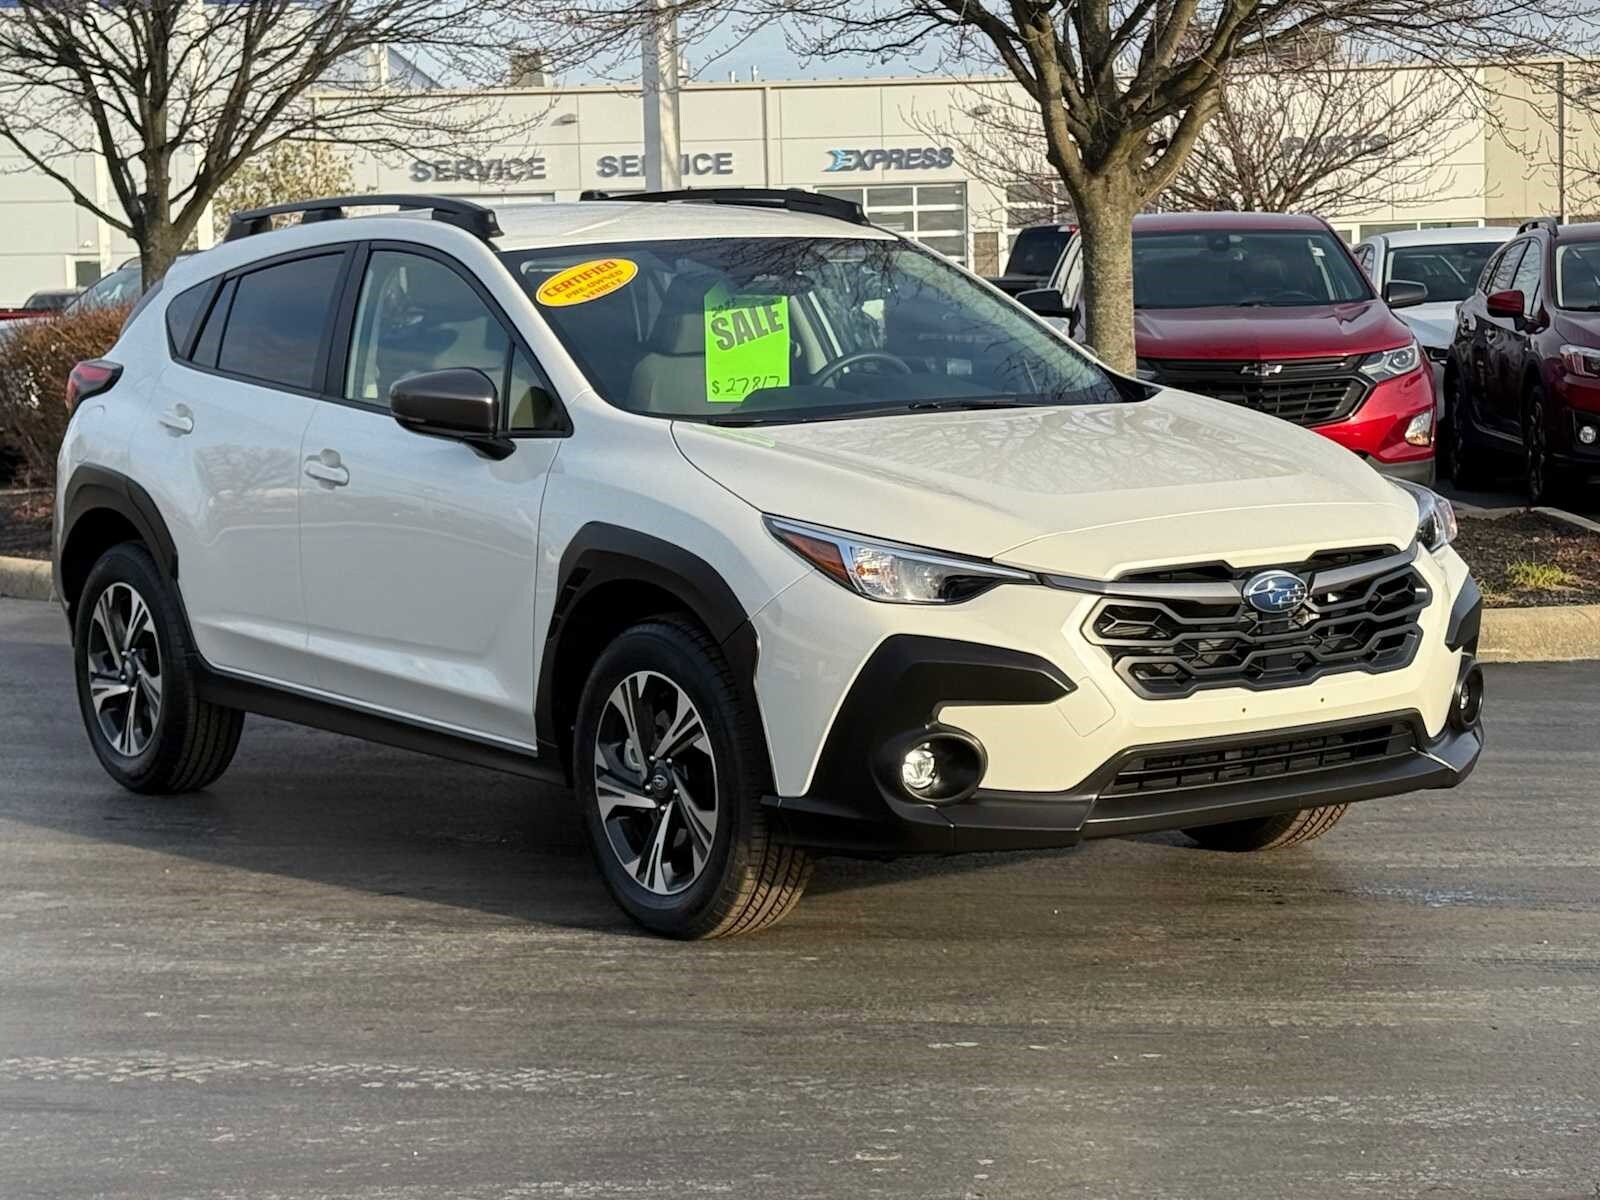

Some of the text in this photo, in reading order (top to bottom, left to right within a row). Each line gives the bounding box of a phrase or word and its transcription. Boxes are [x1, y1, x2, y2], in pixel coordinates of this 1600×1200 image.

[409, 157, 546, 182] SERVICE
[596, 153, 733, 177] SEICE
[823, 147, 954, 172] EXPRESS
[543, 261, 617, 297] CERTIFIED
[711, 299, 784, 350] SALE
